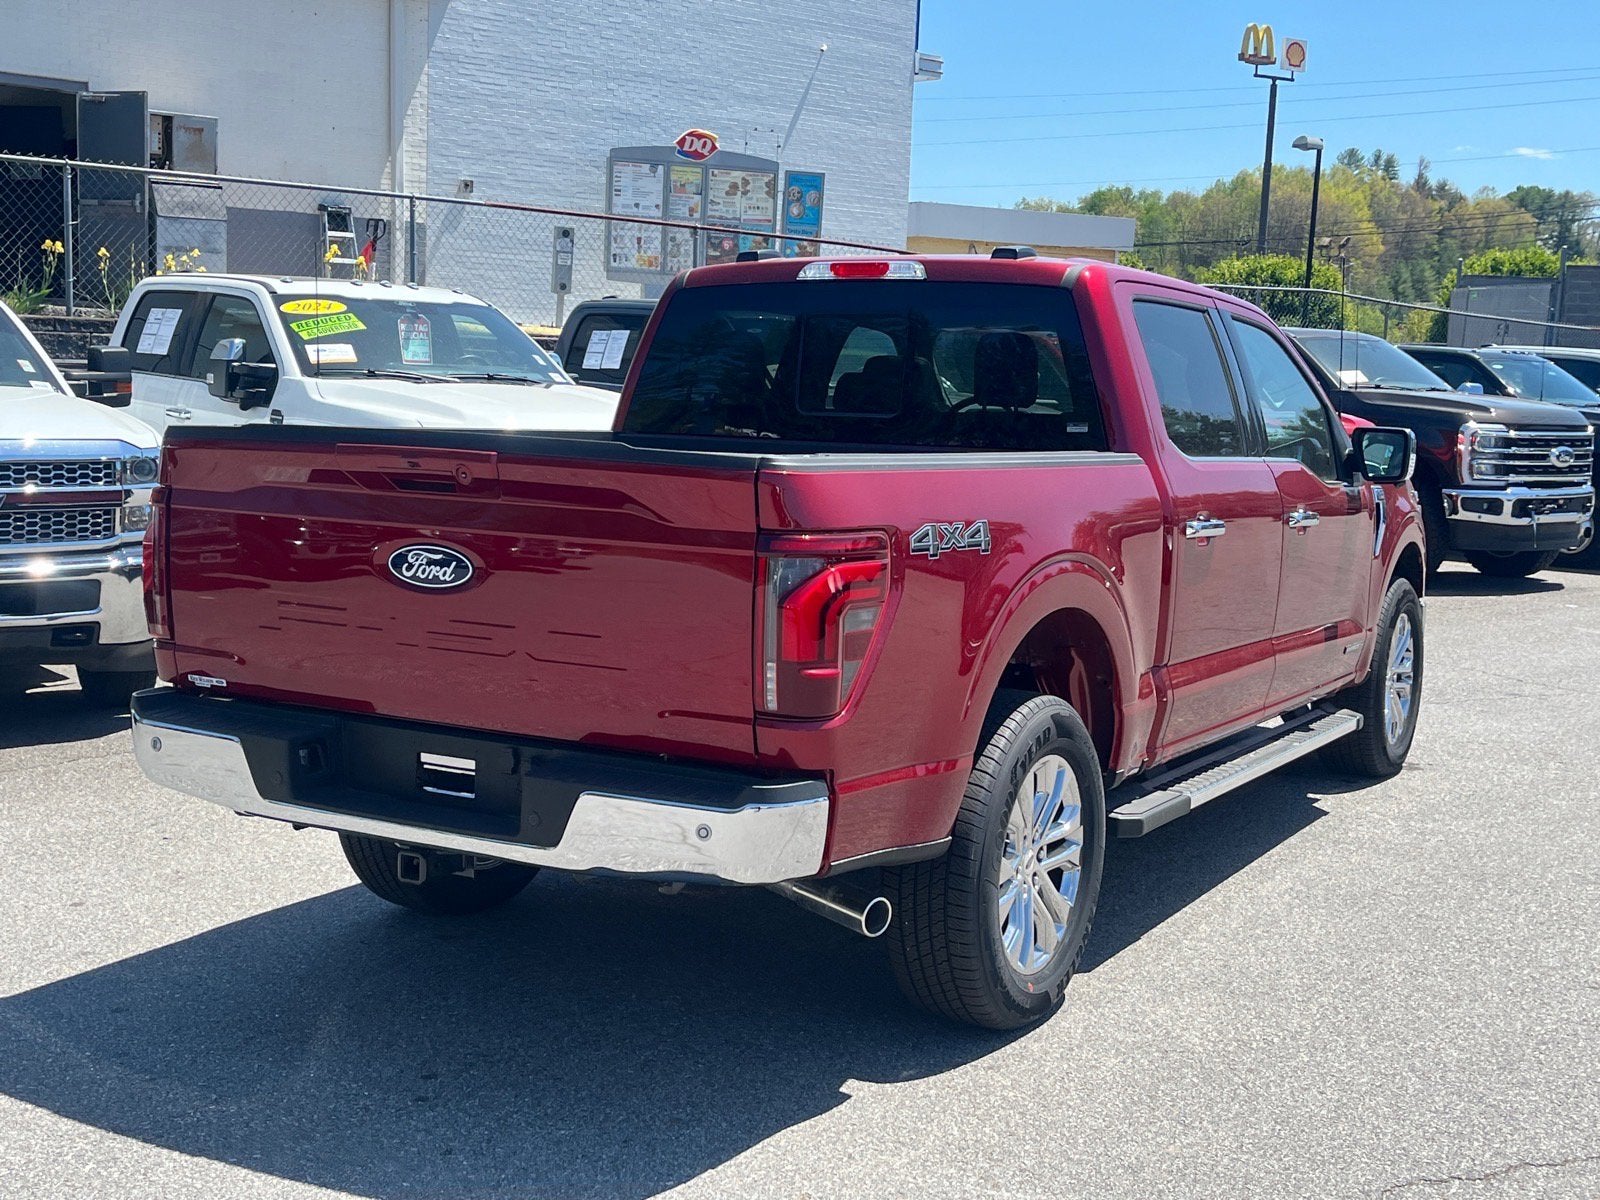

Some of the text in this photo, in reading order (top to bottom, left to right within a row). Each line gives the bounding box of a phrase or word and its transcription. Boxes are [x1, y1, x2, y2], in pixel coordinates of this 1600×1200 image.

[683, 136, 712, 156] DQ
[292, 303, 333, 311] 2024
[296, 314, 352, 330] REDUCED
[402, 550, 457, 582] Ford
